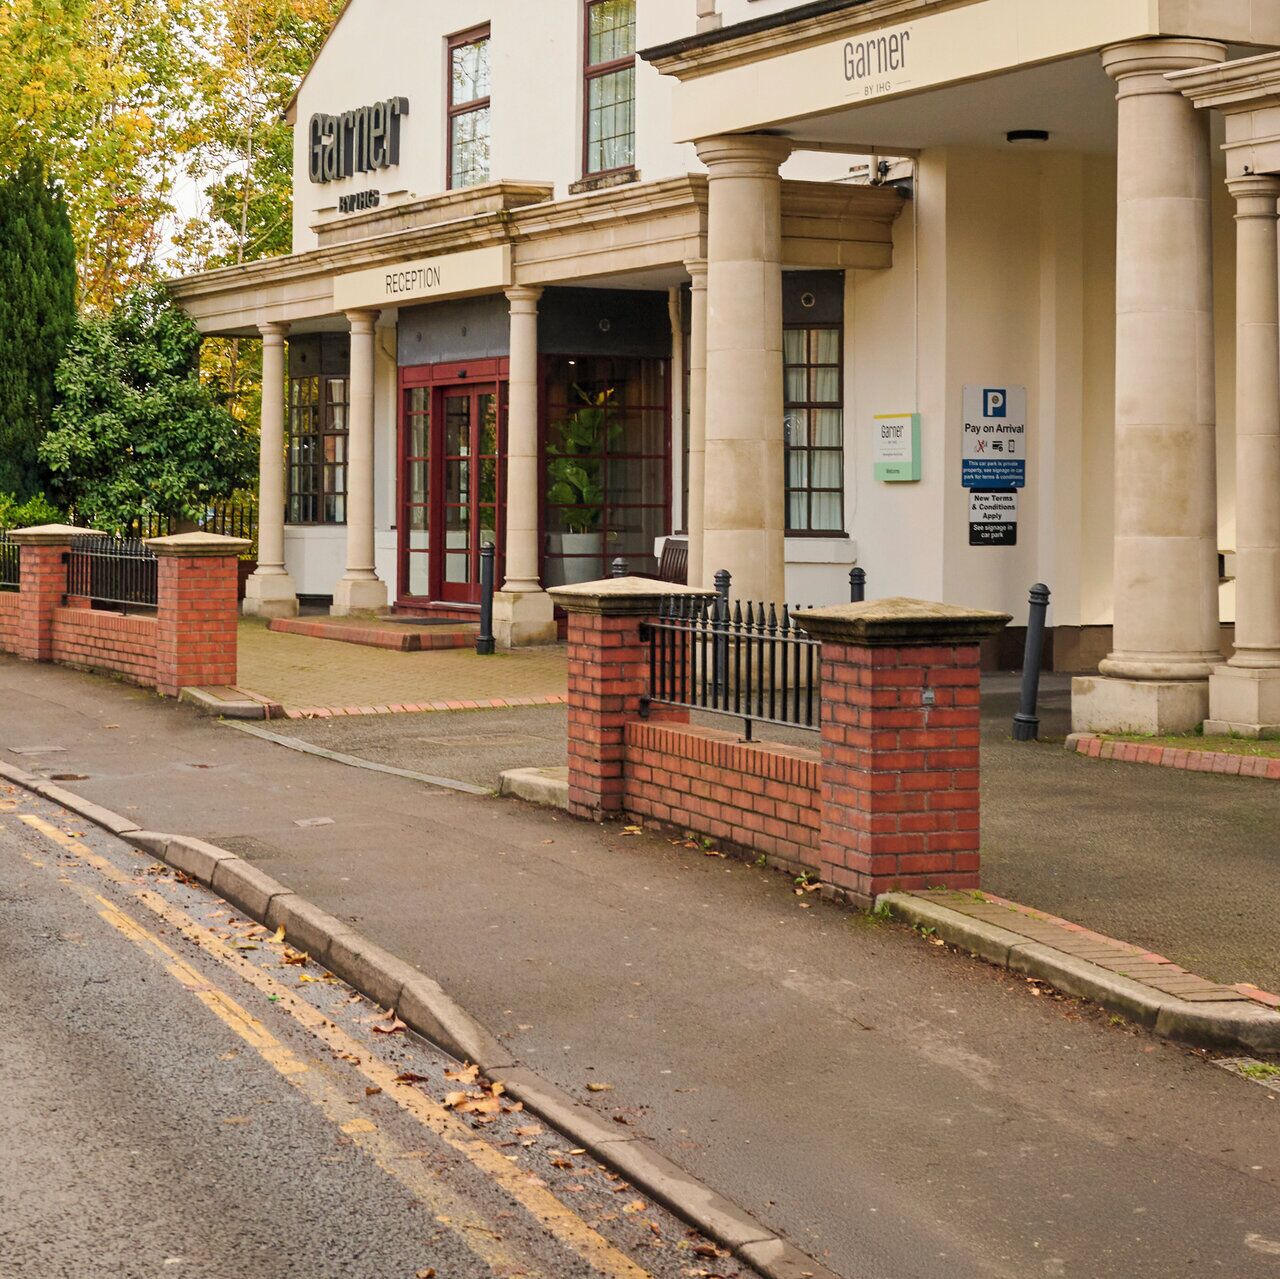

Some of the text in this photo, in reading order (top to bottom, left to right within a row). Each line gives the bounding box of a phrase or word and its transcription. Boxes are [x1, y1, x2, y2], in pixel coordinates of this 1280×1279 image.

[844, 31, 910, 81] Garner
[865, 81, 891, 96] BY IHG
[309, 96, 409, 184] Garner
[339, 195, 355, 214] BY
[386, 266, 441, 294] RECEPTION
[881, 425, 904, 438] Garner
[964, 423, 1025, 435] Pay on Arrival
[983, 512, 1002, 520] Apply
